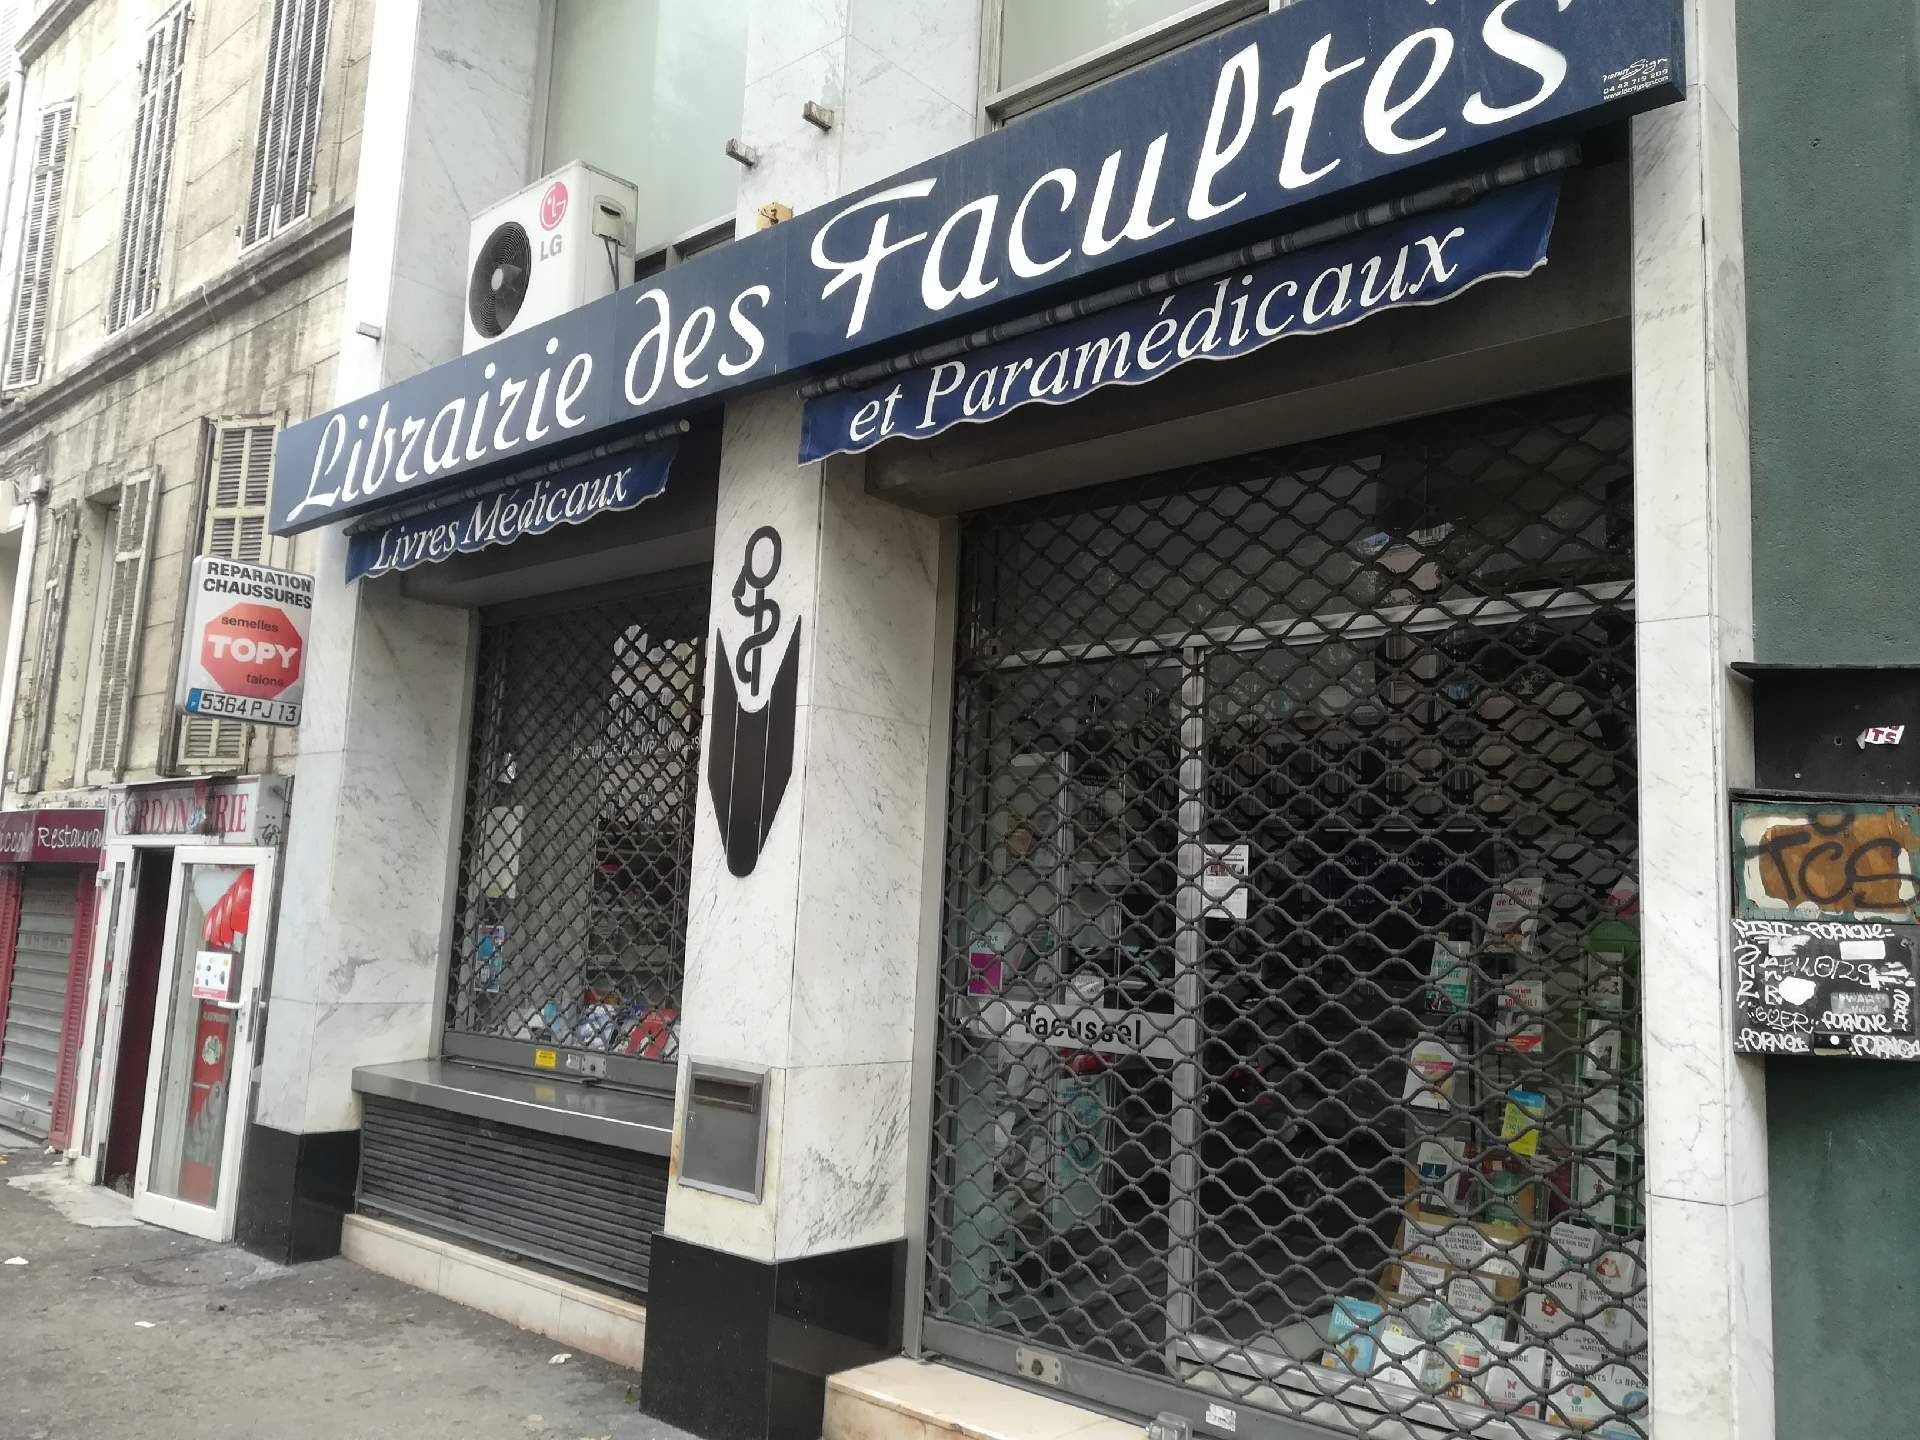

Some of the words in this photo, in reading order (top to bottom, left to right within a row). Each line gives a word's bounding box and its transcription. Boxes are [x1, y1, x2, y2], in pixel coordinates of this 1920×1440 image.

[539, 233, 563, 262] LG
[849, 380, 903, 442] et
[915, 226, 1465, 430] Paramédicaux
[286, 336, 592, 522] Librairie
[624, 284, 771, 406] des
[370, 518, 460, 570] Livres
[461, 467, 632, 545] Médicaux
[207, 561, 312, 593] REPARATION
[203, 578, 312, 609] CHAUSSURES
[221, 615, 279, 632] semelles
[208, 634, 298, 668] TOPY
[246, 674, 284, 687] talons
[201, 693, 246, 715] 5364
[250, 701, 273, 719] PJ
[278, 704, 297, 722] 13
